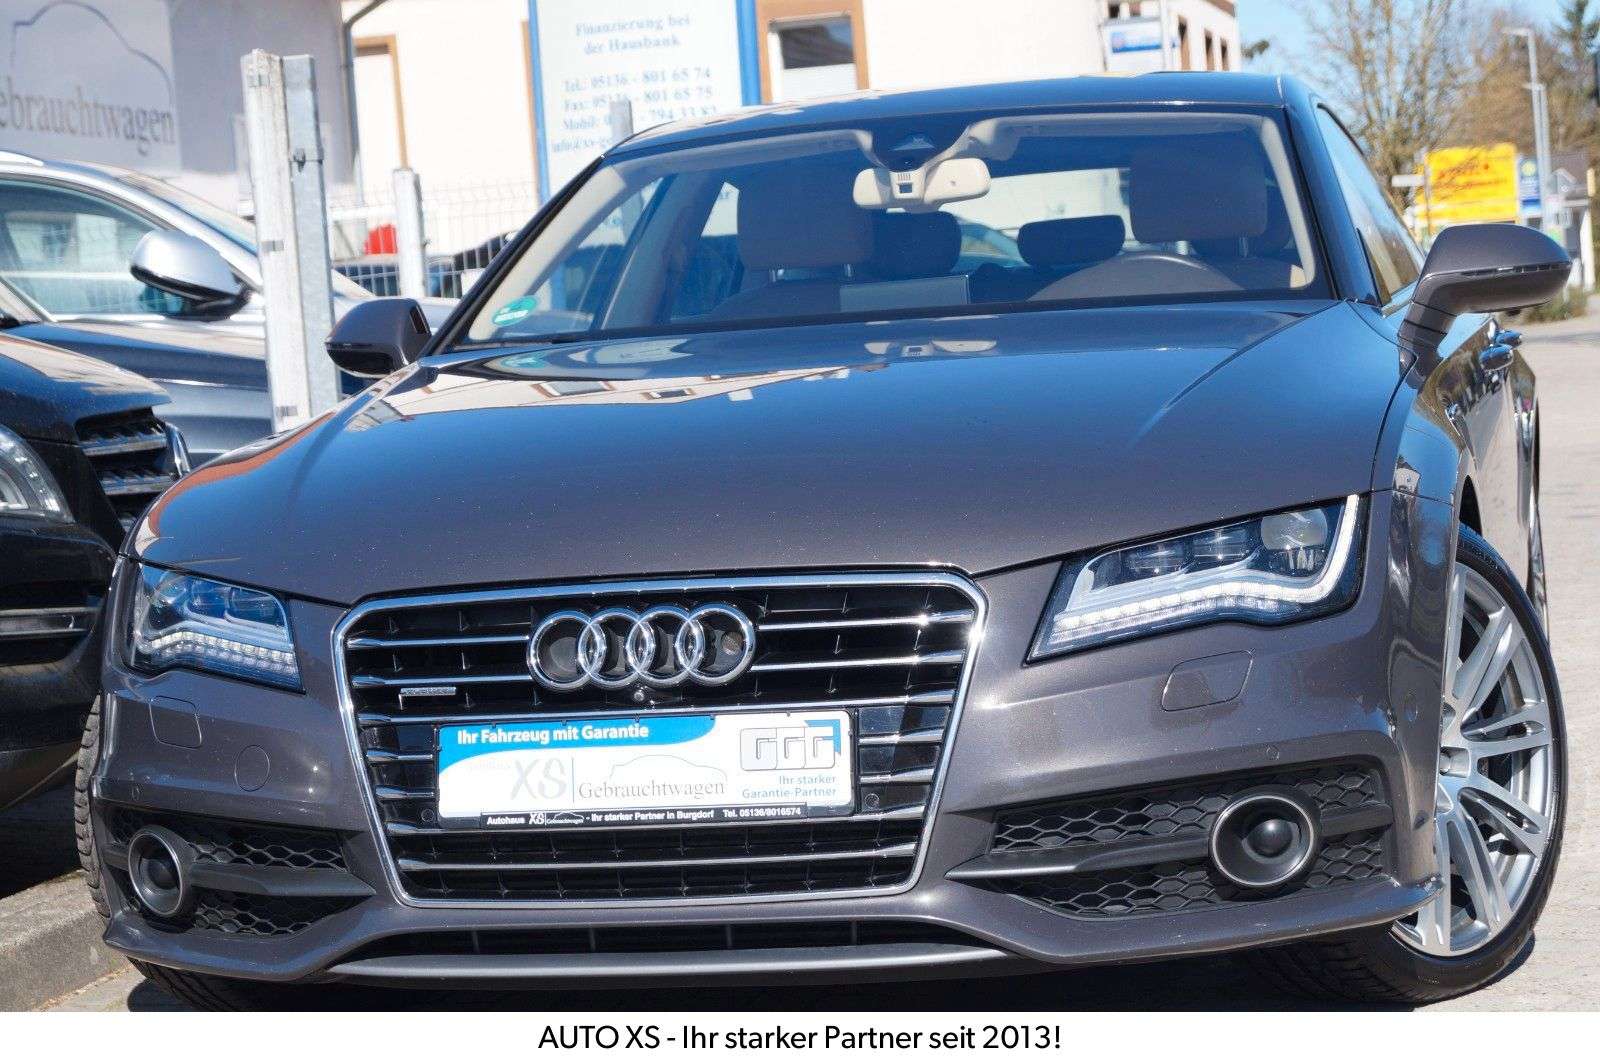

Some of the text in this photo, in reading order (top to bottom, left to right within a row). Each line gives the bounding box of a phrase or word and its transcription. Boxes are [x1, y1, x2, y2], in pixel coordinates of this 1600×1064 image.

[667, 14, 690, 27] bei
[608, 35, 680, 52] Hausbank
[457, 723, 650, 745] Ihr Fahrzeug mit Garantie
[779, 774, 837, 785] Ihr starker
[578, 777, 726, 800] Gebrauchtwagen
[486, 816, 526, 826] Autohaus
[591, 813, 602, 822] Ihr
[604, 812, 634, 822] starker
[634, 810, 665, 820] Partner
[666, 810, 676, 820] in
[676, 808, 715, 821] Burgdorf
[723, 808, 738, 818] Tel.
